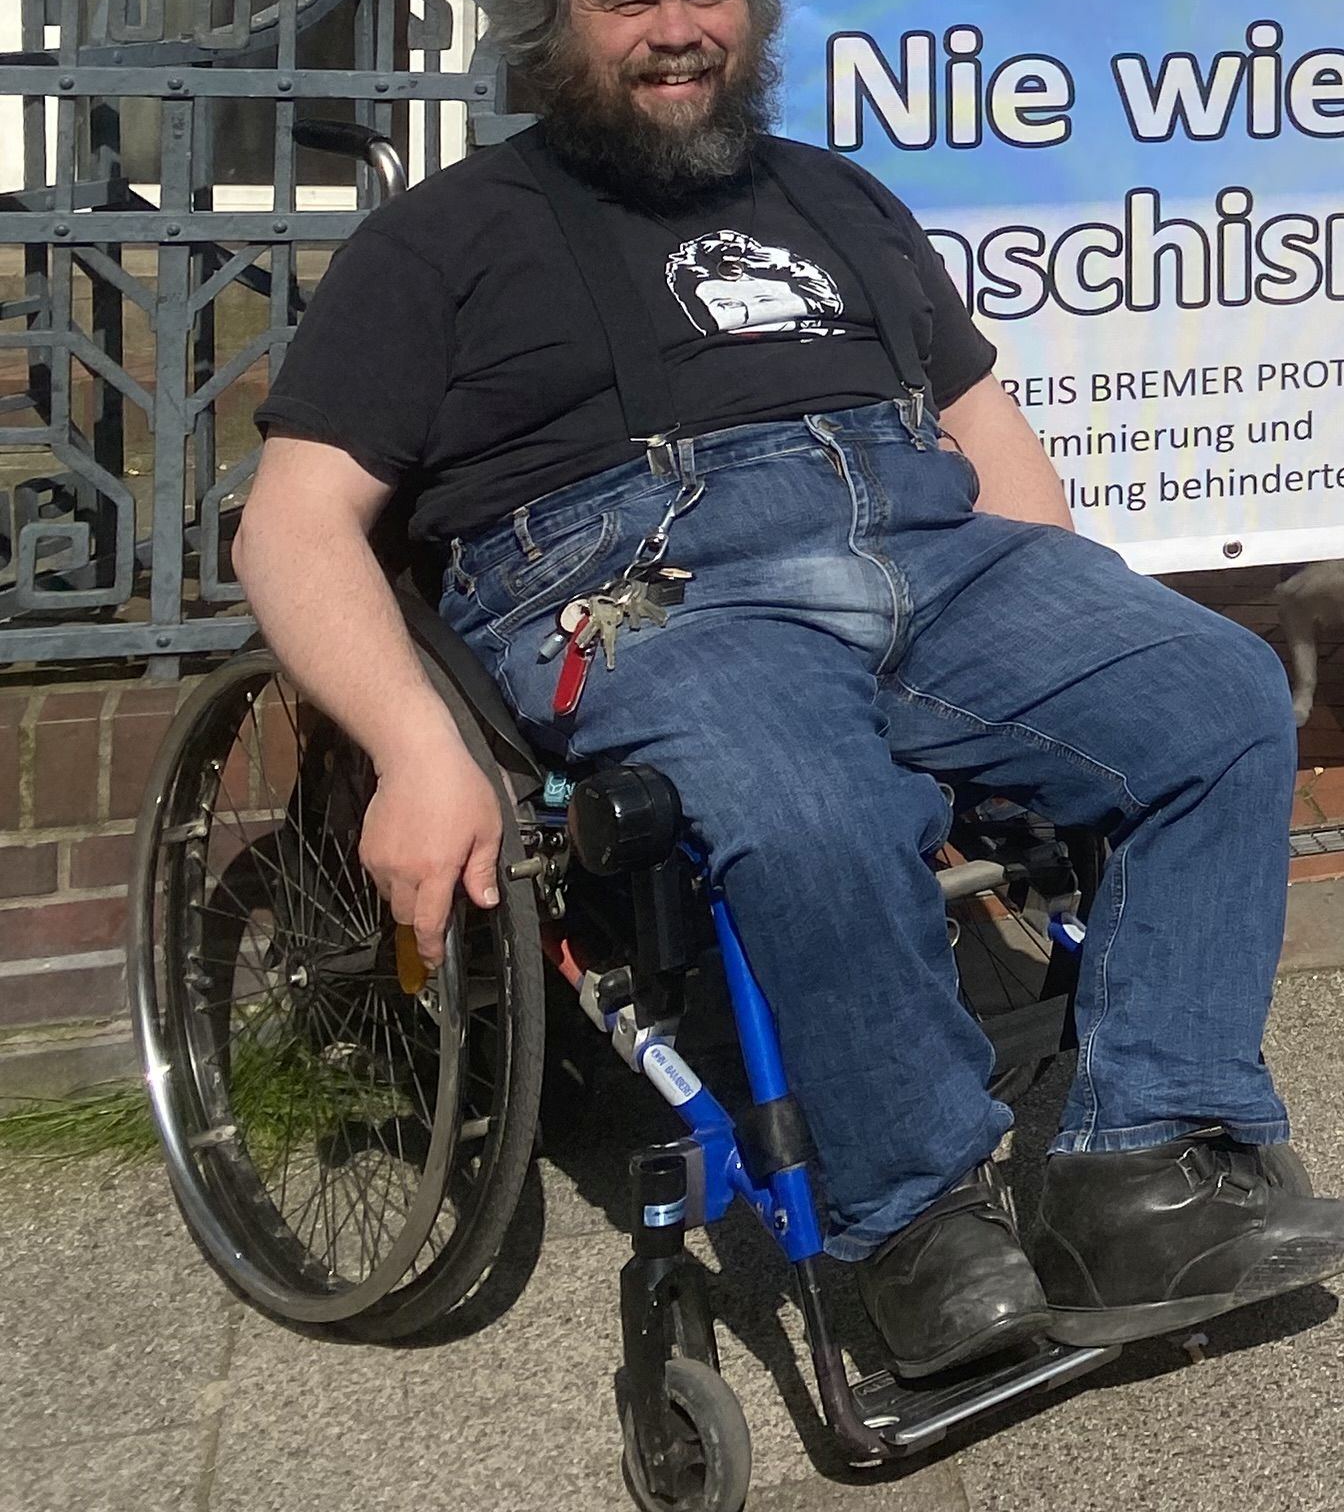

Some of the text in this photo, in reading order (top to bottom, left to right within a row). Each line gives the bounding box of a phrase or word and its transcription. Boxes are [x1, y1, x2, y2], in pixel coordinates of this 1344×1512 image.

[826, 23, 1075, 152] Nie
[1001, 375, 1078, 407] REIS
[1091, 365, 1244, 403] BREMER
[1039, 410, 1313, 459] iminierung und
